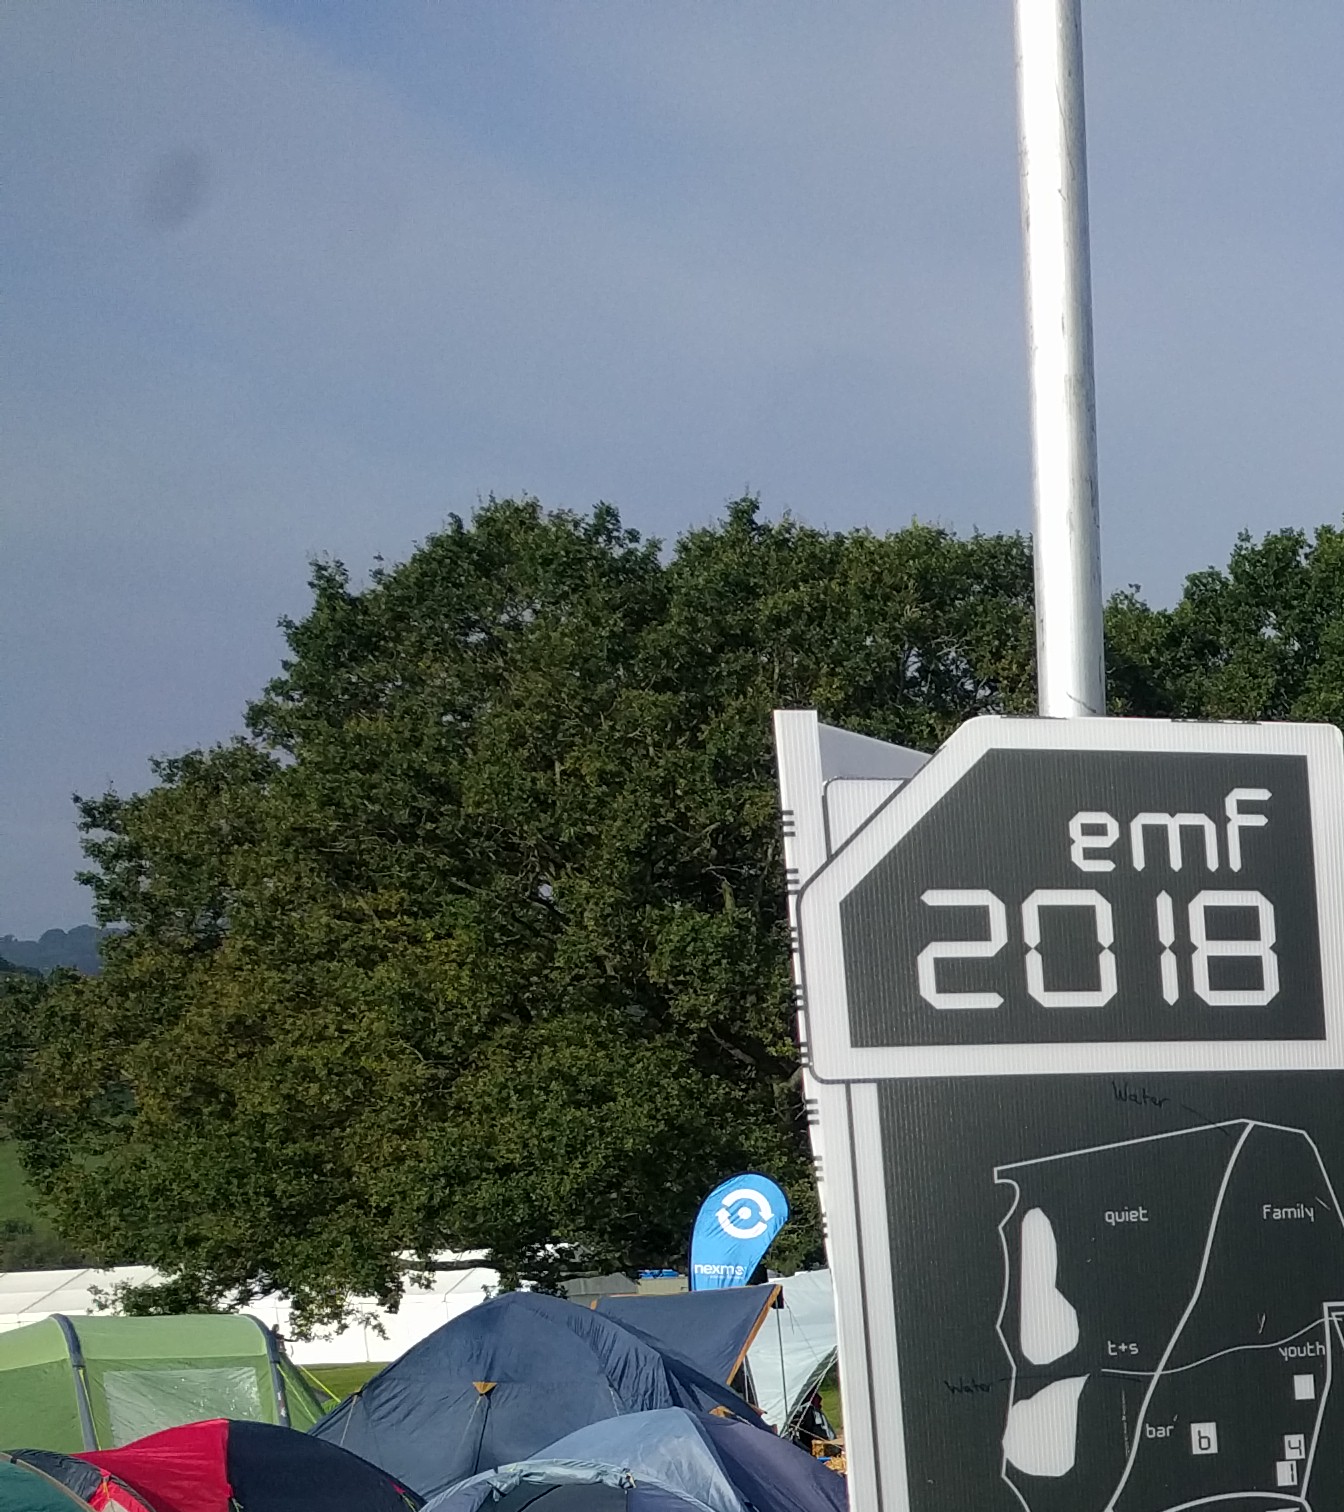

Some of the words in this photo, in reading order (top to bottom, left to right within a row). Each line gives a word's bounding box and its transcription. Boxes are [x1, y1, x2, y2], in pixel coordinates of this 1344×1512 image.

[916, 888, 1281, 1010] 2018
[1105, 1206, 1149, 1226] quiet
[694, 1264, 745, 1276] nexmo
[1279, 1341, 1326, 1361] youth
[1146, 1422, 1174, 1438] bar
